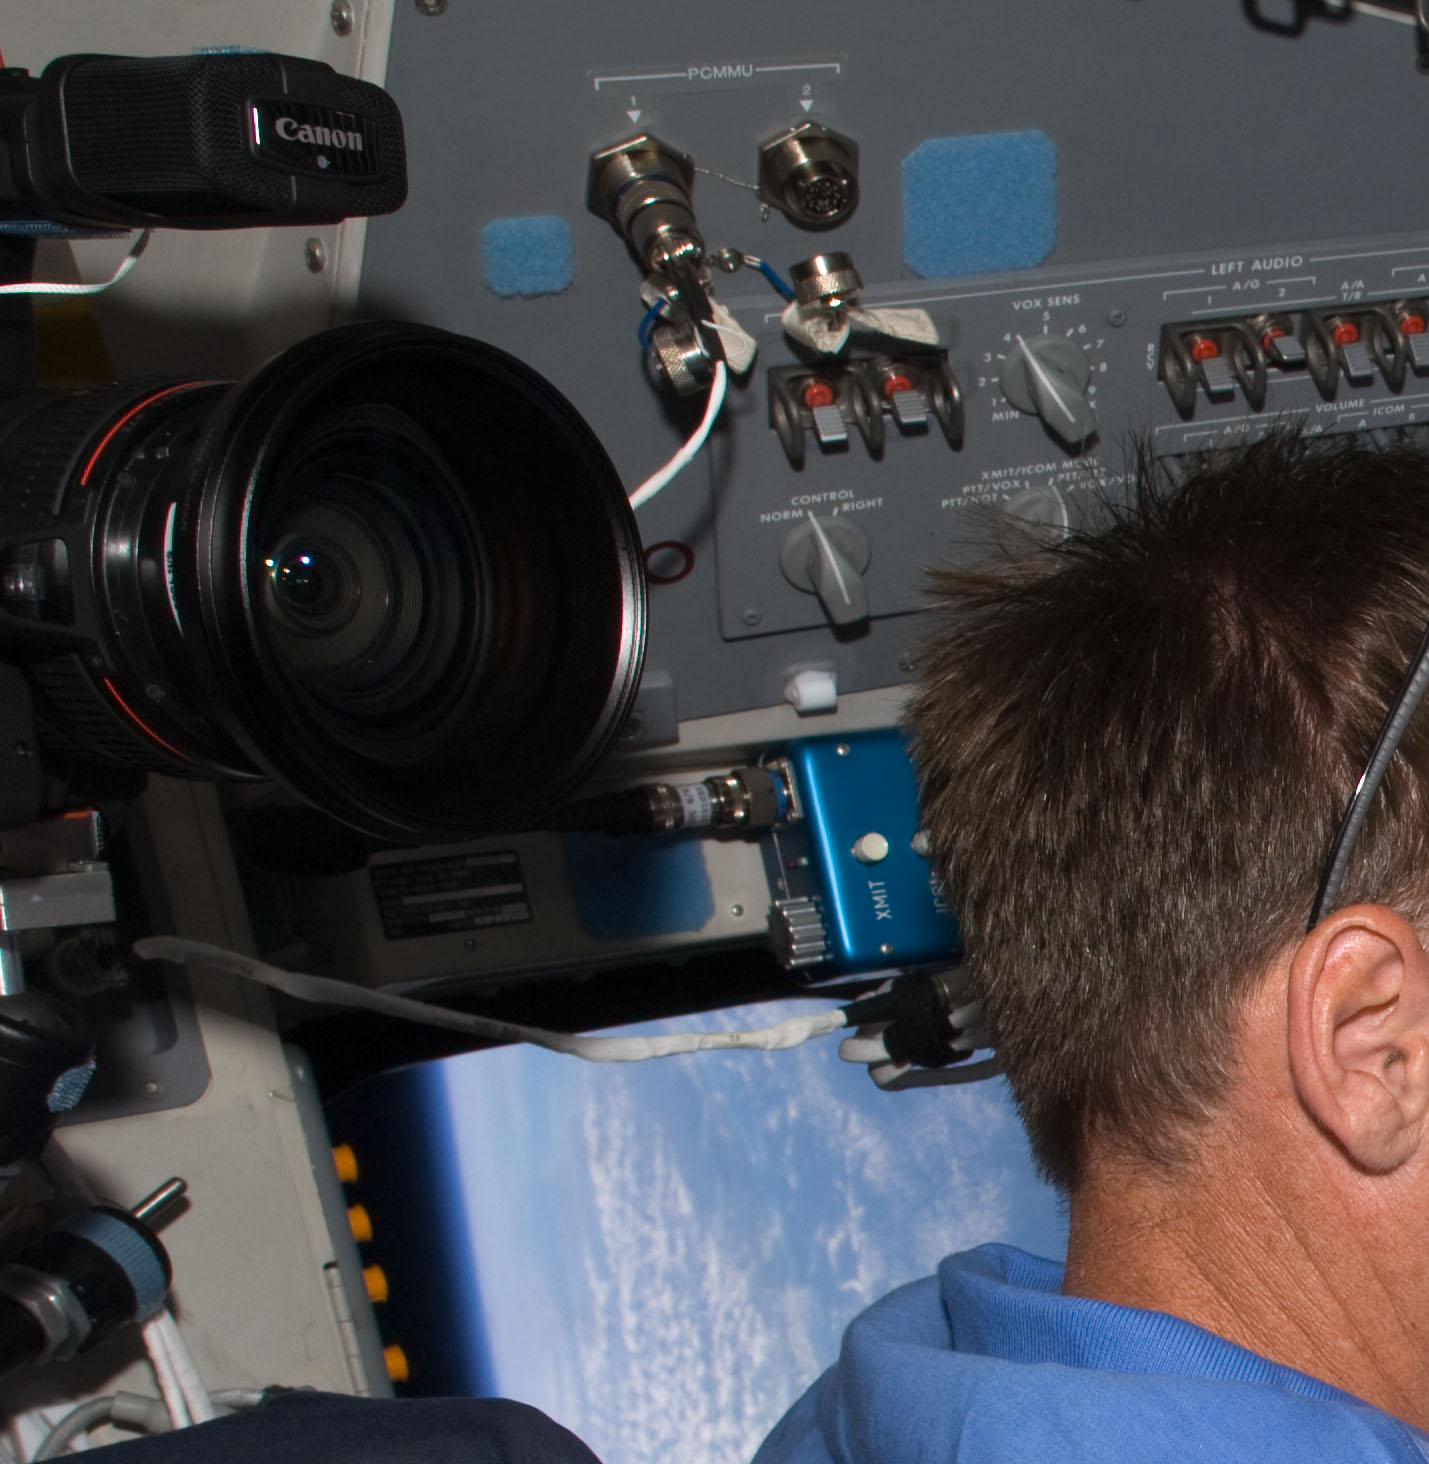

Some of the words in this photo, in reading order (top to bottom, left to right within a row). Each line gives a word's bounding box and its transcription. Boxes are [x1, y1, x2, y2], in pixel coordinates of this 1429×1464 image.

[688, 64, 753, 80] PCMMU
[275, 117, 363, 151] Canon
[1211, 261, 1244, 276] LEFT
[1250, 255, 1304, 273] AUDIO
[1232, 278, 1260, 292] A/G
[1012, 299, 1041, 311] VOX
[1047, 294, 1080, 307] SENS
[1315, 399, 1364, 413] VOLUME
[992, 410, 1020, 422] MIN
[981, 462, 1058, 482] XMIT/ICOM
[791, 488, 855, 507] CONTROL
[843, 498, 884, 513] RIGHT
[760, 509, 804, 523] NORM
[868, 880, 892, 920] XMIT
